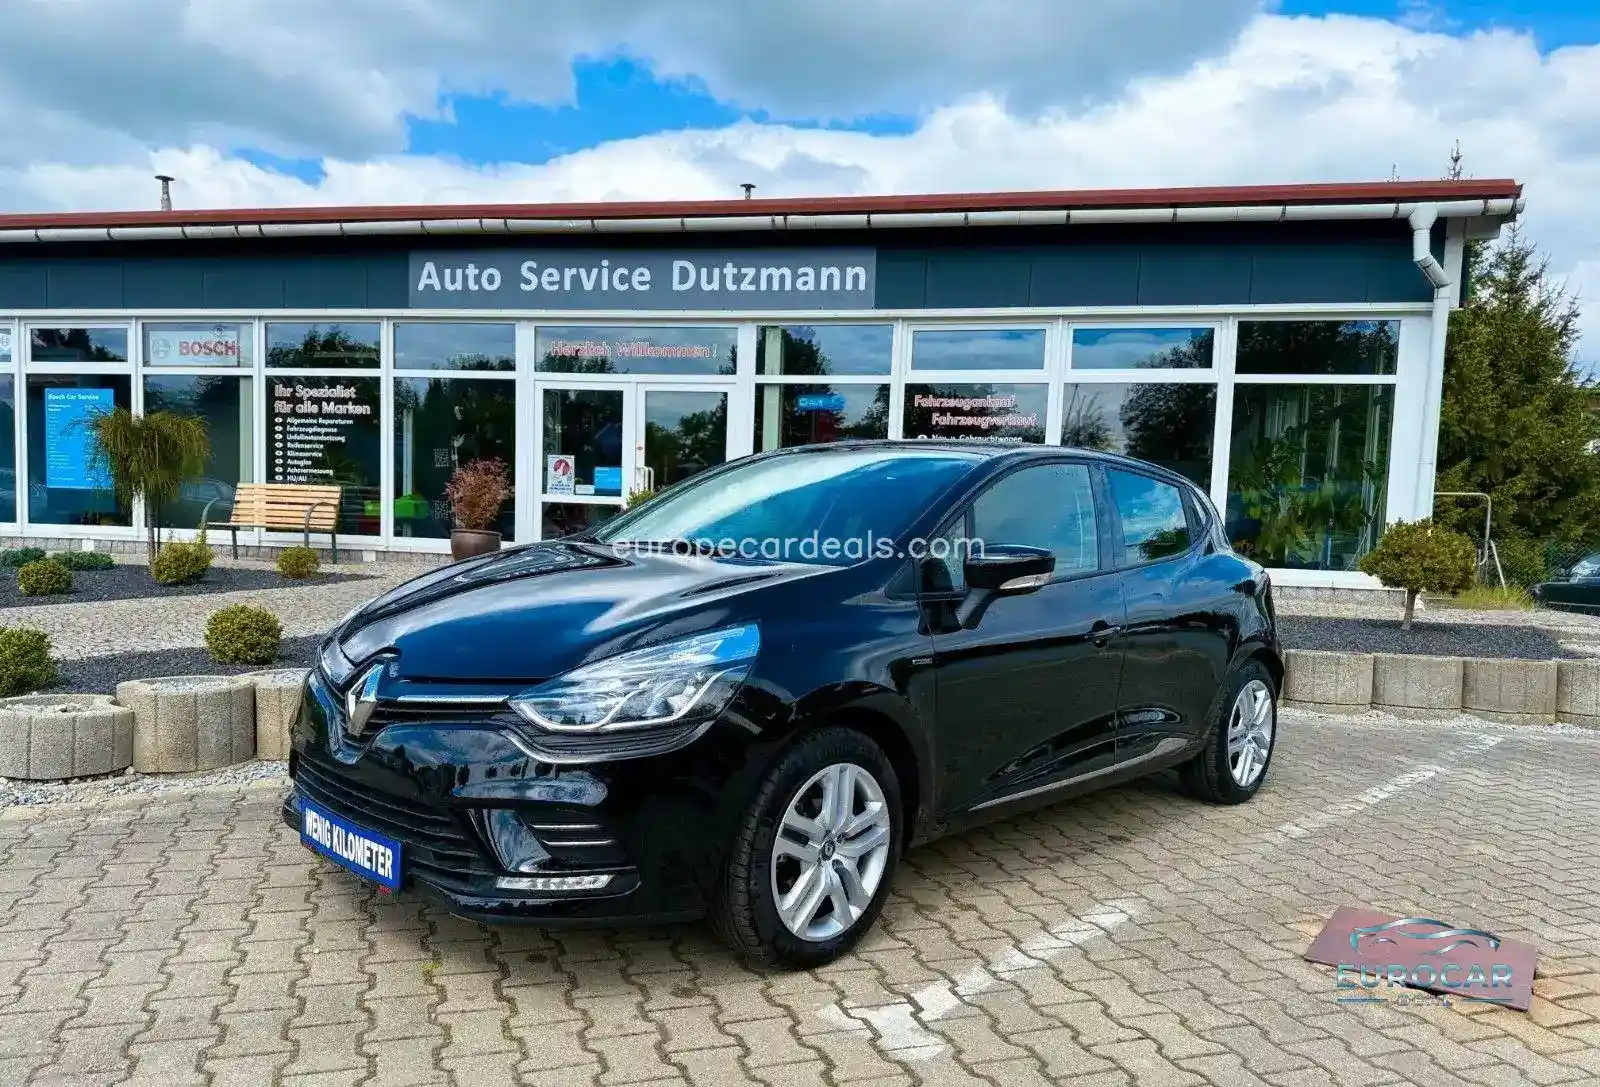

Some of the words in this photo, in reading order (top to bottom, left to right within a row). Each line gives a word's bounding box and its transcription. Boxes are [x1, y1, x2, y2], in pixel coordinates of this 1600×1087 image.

[417, 261, 502, 291] Auto
[519, 259, 652, 292] Service
[671, 259, 867, 292] Dutzmann
[179, 340, 236, 356] BOSCH
[550, 340, 612, 357] Herzlich
[274, 384, 293, 397] Ihr
[295, 384, 356, 400] Spezialist
[274, 400, 294, 413] für
[295, 400, 319, 414] alle
[321, 401, 371, 415] Marken
[914, 394, 1016, 411] Fahrzeugankauf
[286, 417, 317, 425] Allgemeine
[318, 417, 354, 425] Reparaturen
[931, 413, 1037, 429] Fahrzeugverkauf
[286, 425, 338, 434] Fahrzeugdiagnose
[286, 459, 312, 467] Autoglas
[305, 806, 331, 849] WENIG
[332, 822, 393, 880] KILOMETER
